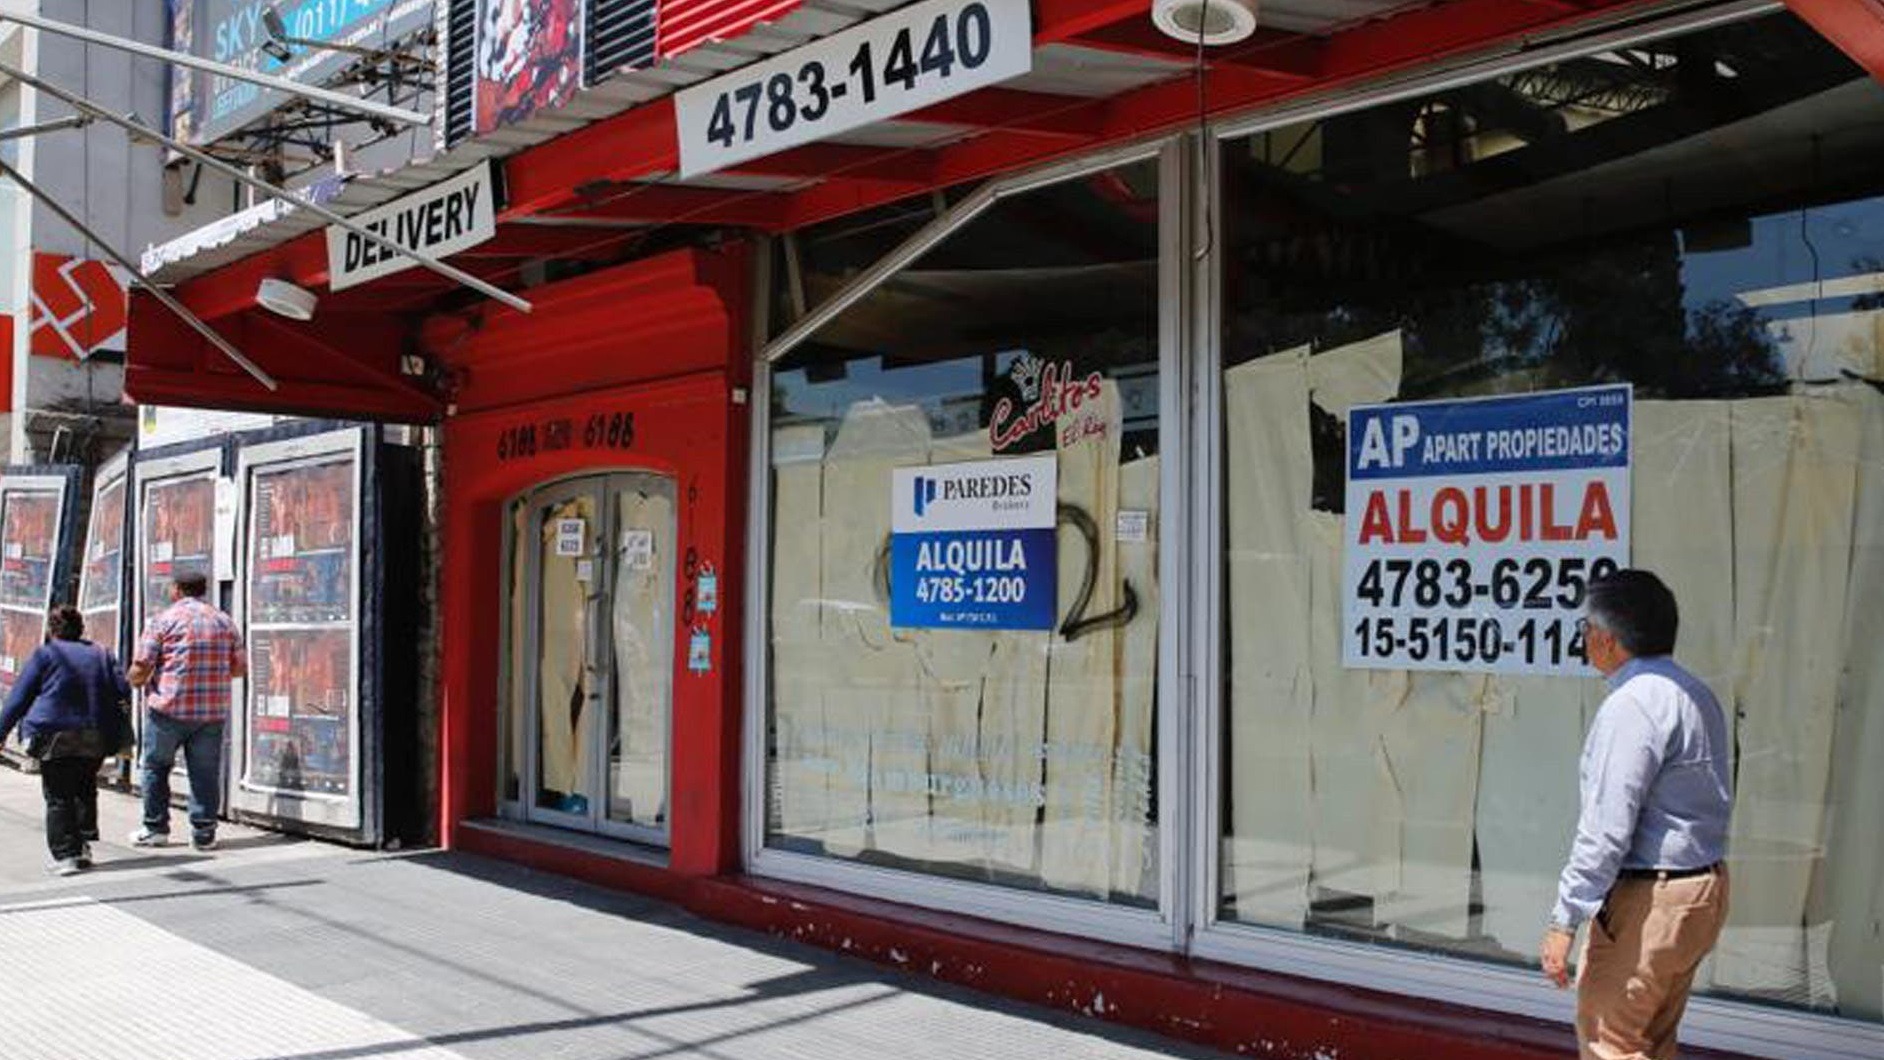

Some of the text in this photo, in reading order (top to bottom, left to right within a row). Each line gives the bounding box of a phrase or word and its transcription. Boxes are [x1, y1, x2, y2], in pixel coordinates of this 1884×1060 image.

[215, 1, 261, 61] SKY
[707, 2, 992, 147] 4783-1440
[344, 182, 480, 274] DELIVERY
[584, 412, 634, 448] 6188
[990, 360, 1102, 451] Carlitos
[1357, 415, 1623, 469] AP APART PROPIEDADES
[944, 474, 1031, 500] PAREDES
[1359, 481, 1617, 547] ALQUILA
[916, 540, 1026, 577] ALQUILA
[916, 577, 1025, 604] 4785-1200
